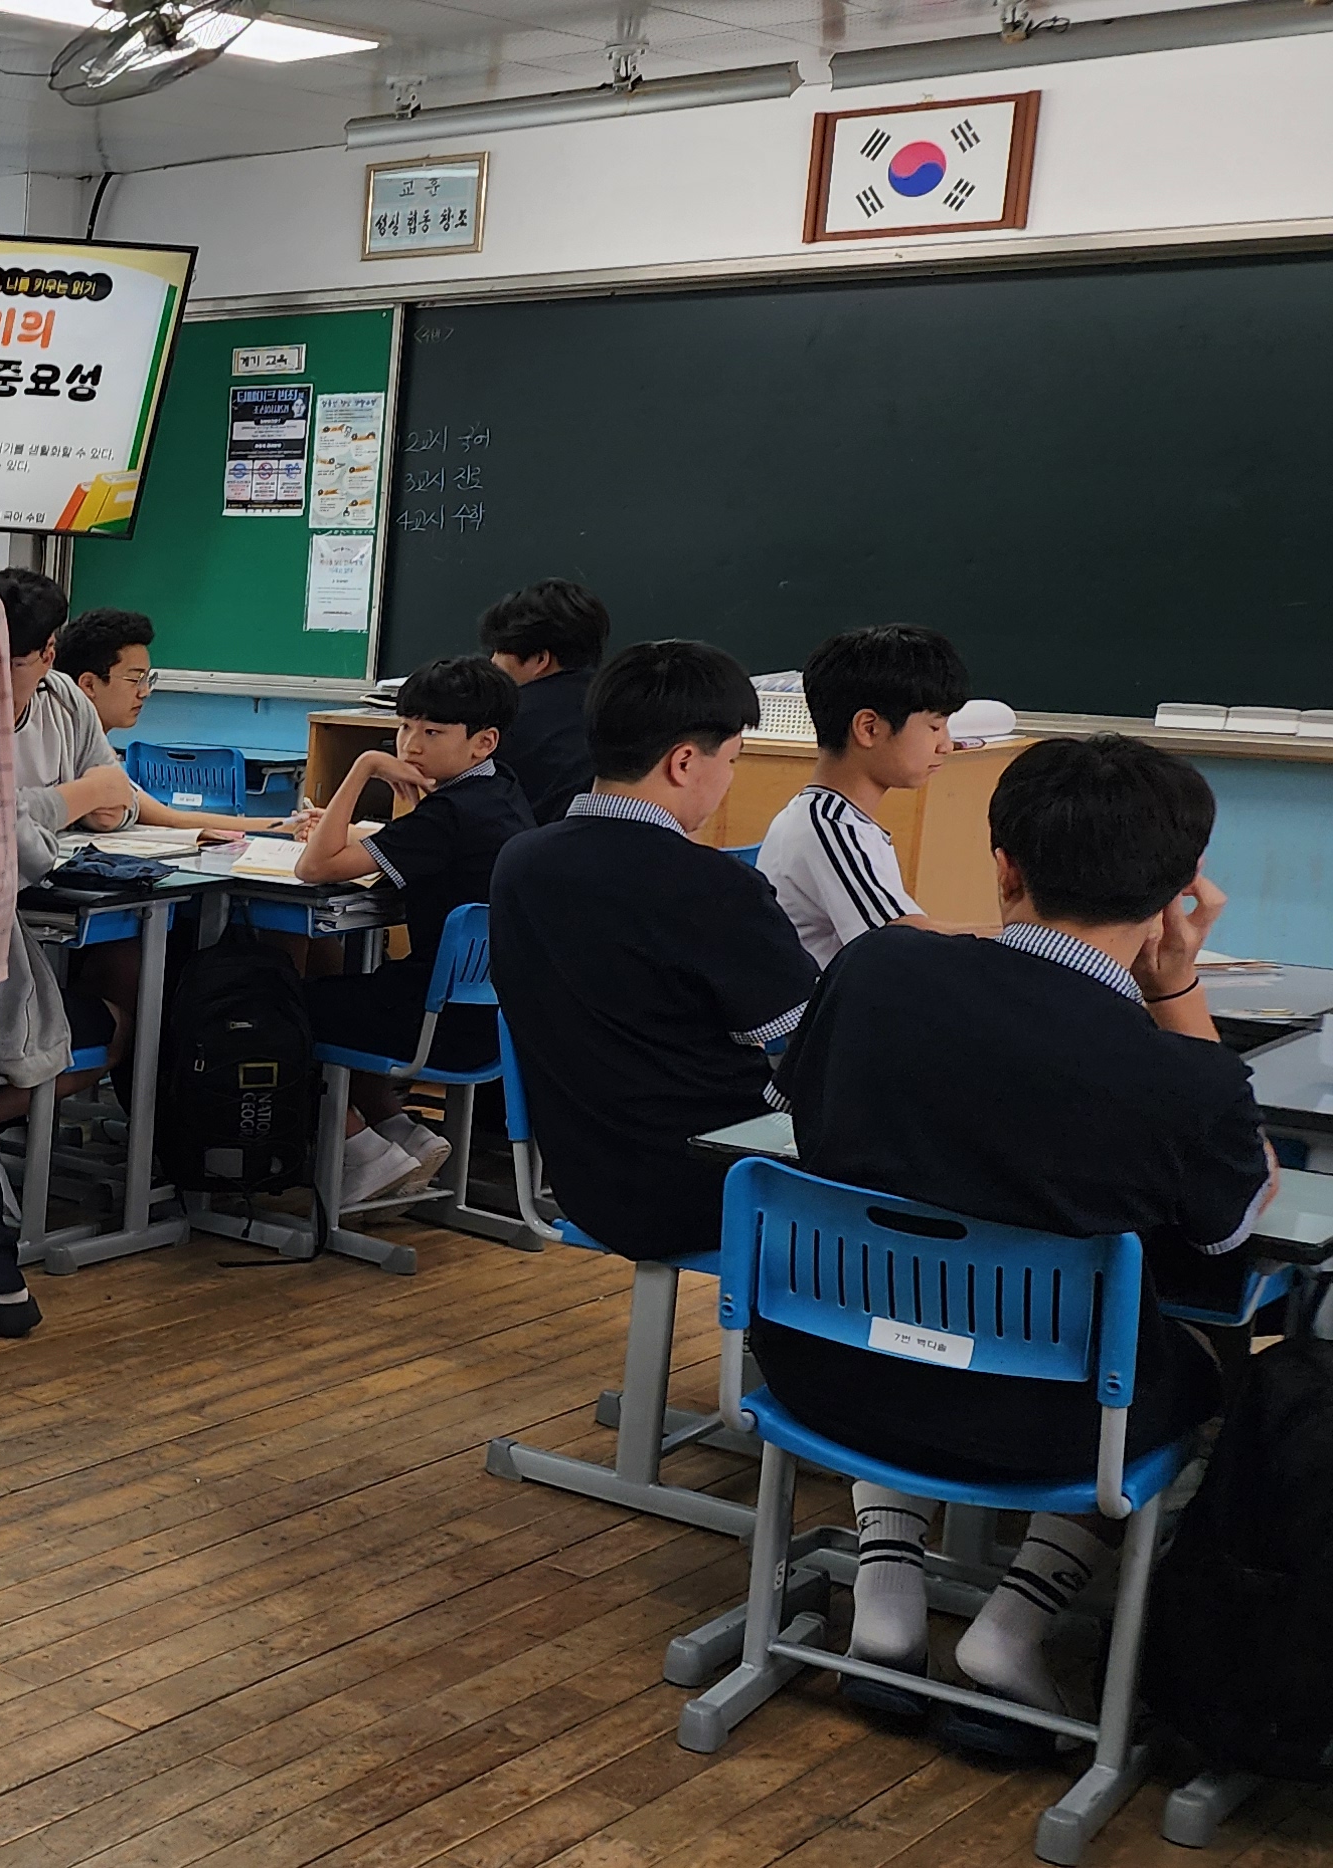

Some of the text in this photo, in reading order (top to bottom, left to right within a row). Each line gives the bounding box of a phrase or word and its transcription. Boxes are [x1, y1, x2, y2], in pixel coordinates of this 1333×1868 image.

[375, 206, 468, 237] 성실 협동 창조
[33, 278, 68, 295] 키우는
[71, 280, 96, 296] 읽기
[75, 447, 86, 459] 수
[405, 467, 445, 492] 3교시
[396, 504, 445, 531] 4교시
